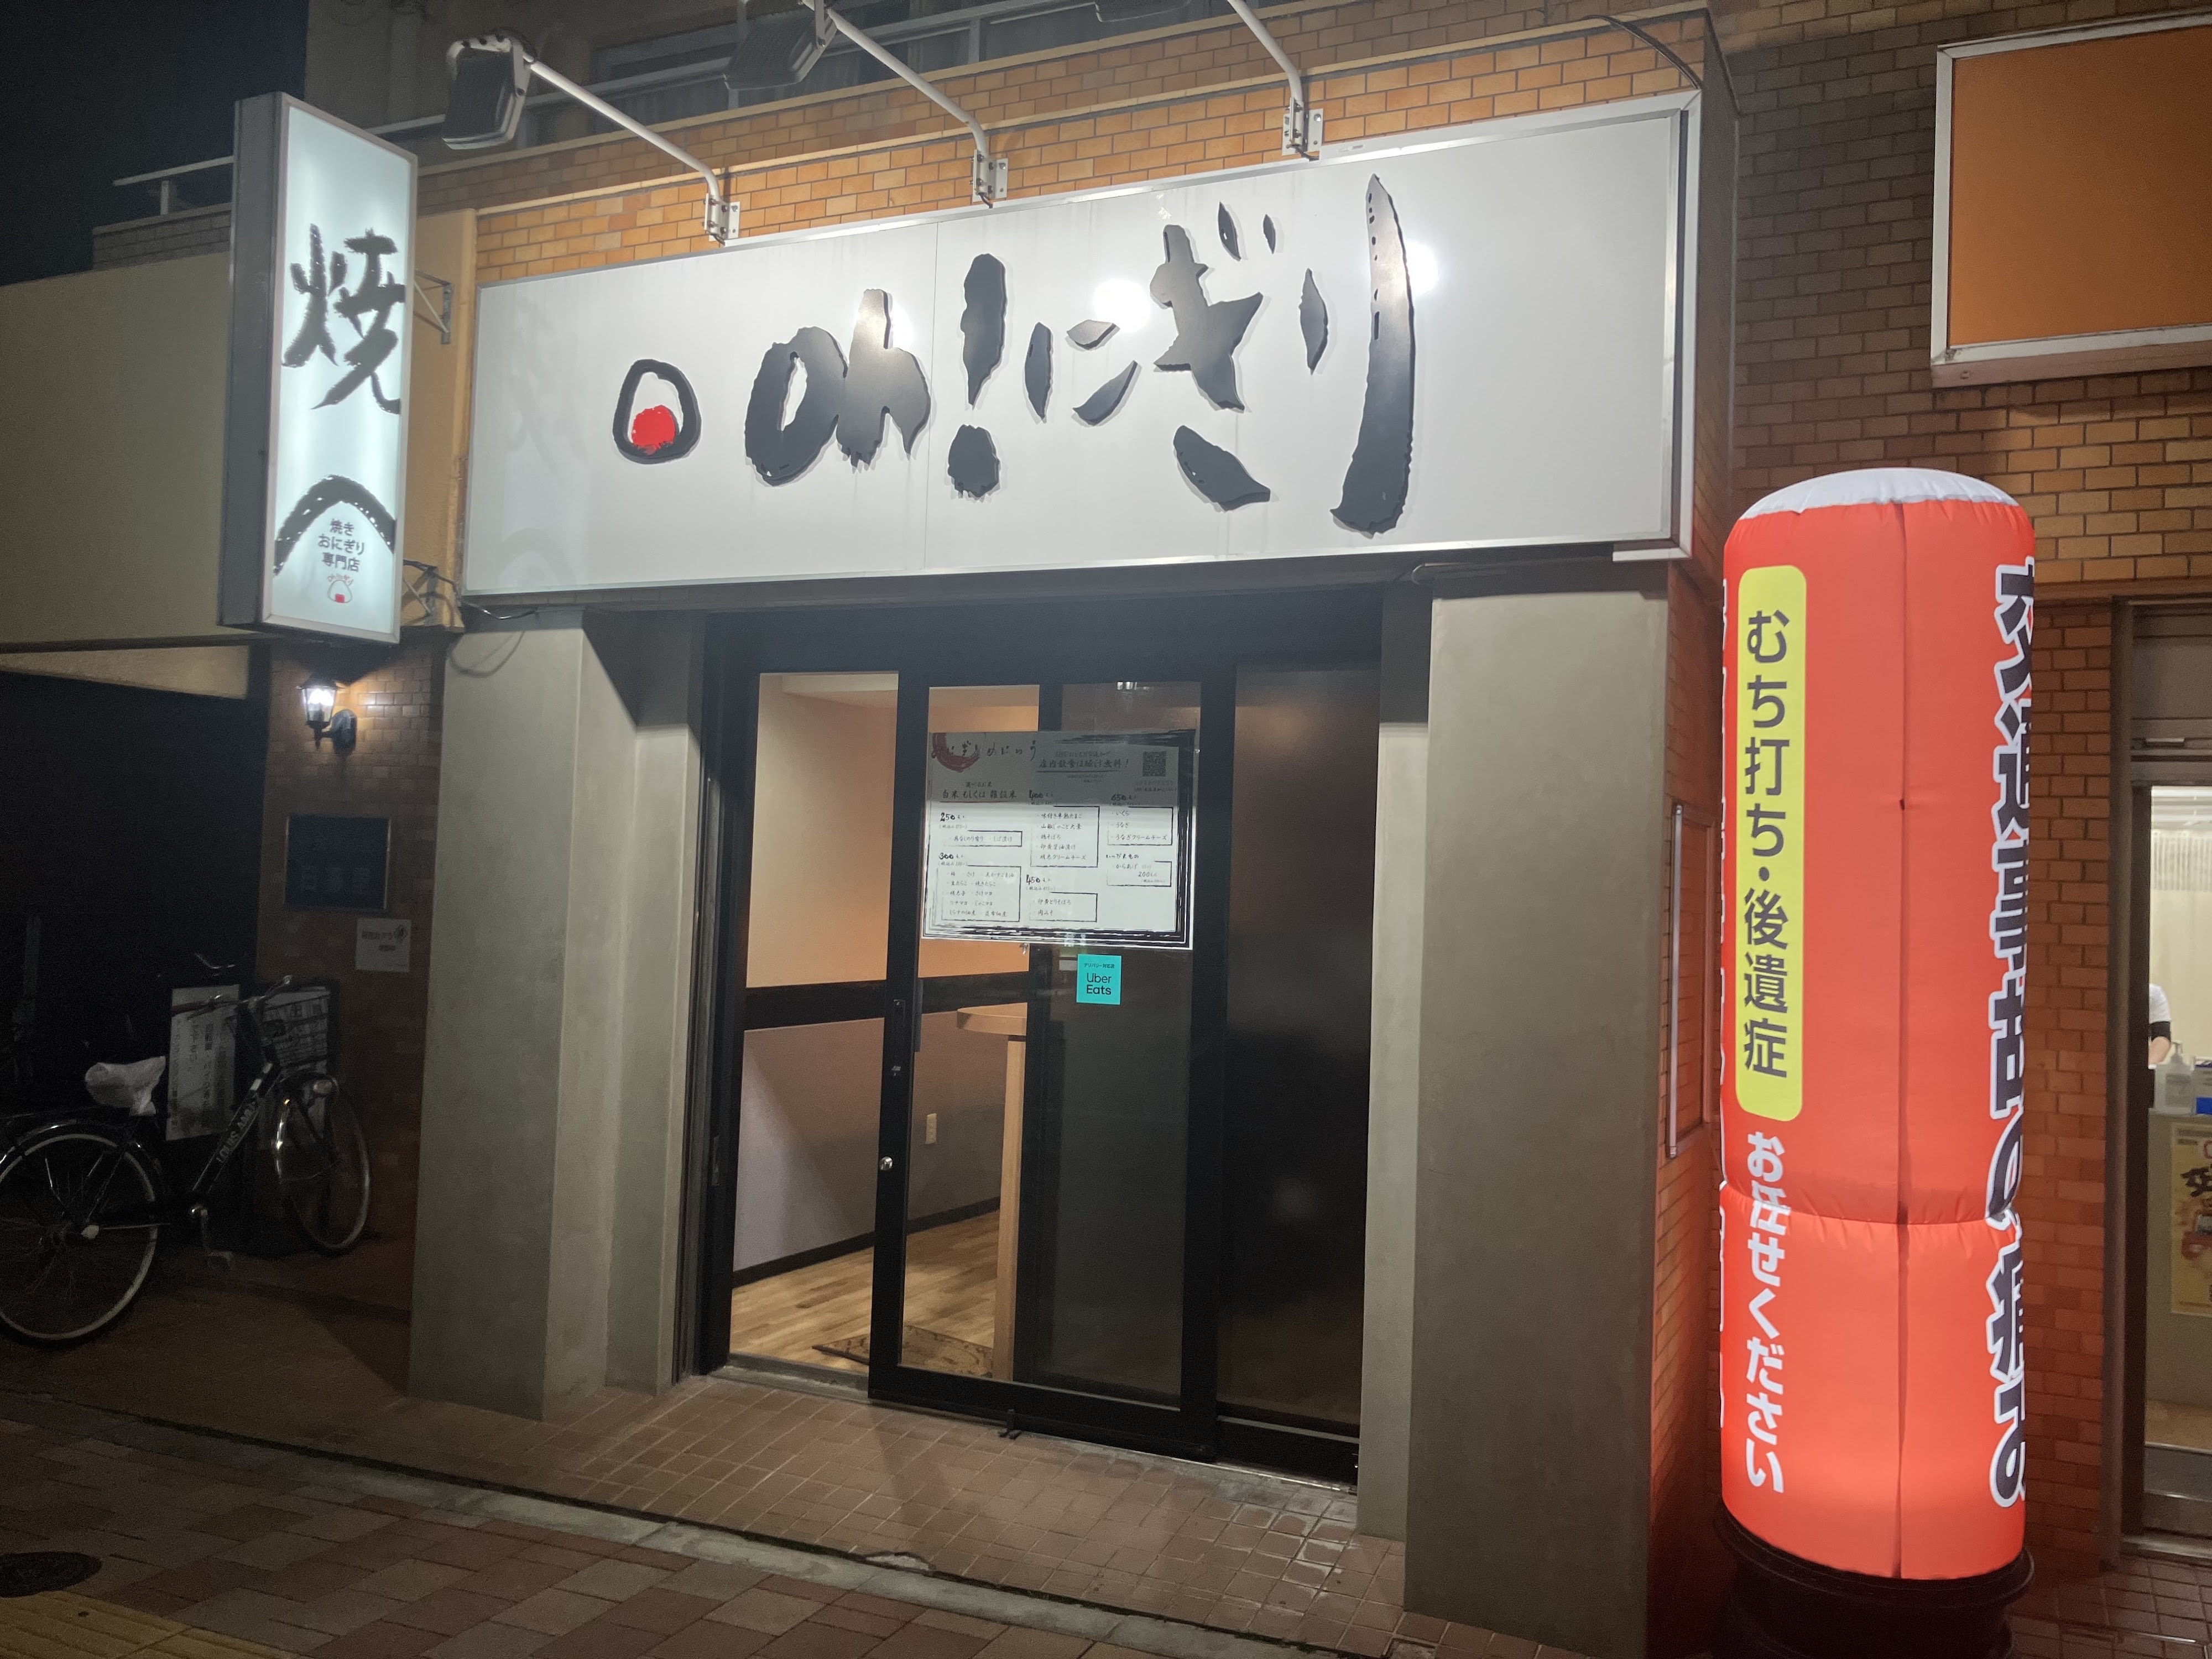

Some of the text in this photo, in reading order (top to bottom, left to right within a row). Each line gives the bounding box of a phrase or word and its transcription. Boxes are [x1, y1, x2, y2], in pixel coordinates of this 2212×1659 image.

[282, 224, 405, 415] 焼
[330, 518, 354, 536] 焼き
[318, 533, 364, 555] おにぎり
[322, 552, 360, 572] 専門店
[1743, 609, 1790, 1079] むち打ち・後遺症
[1087, 973, 1112, 983] Uber
[1087, 984, 1112, 995] Eats
[1745, 1131, 1791, 1494] お任せください
